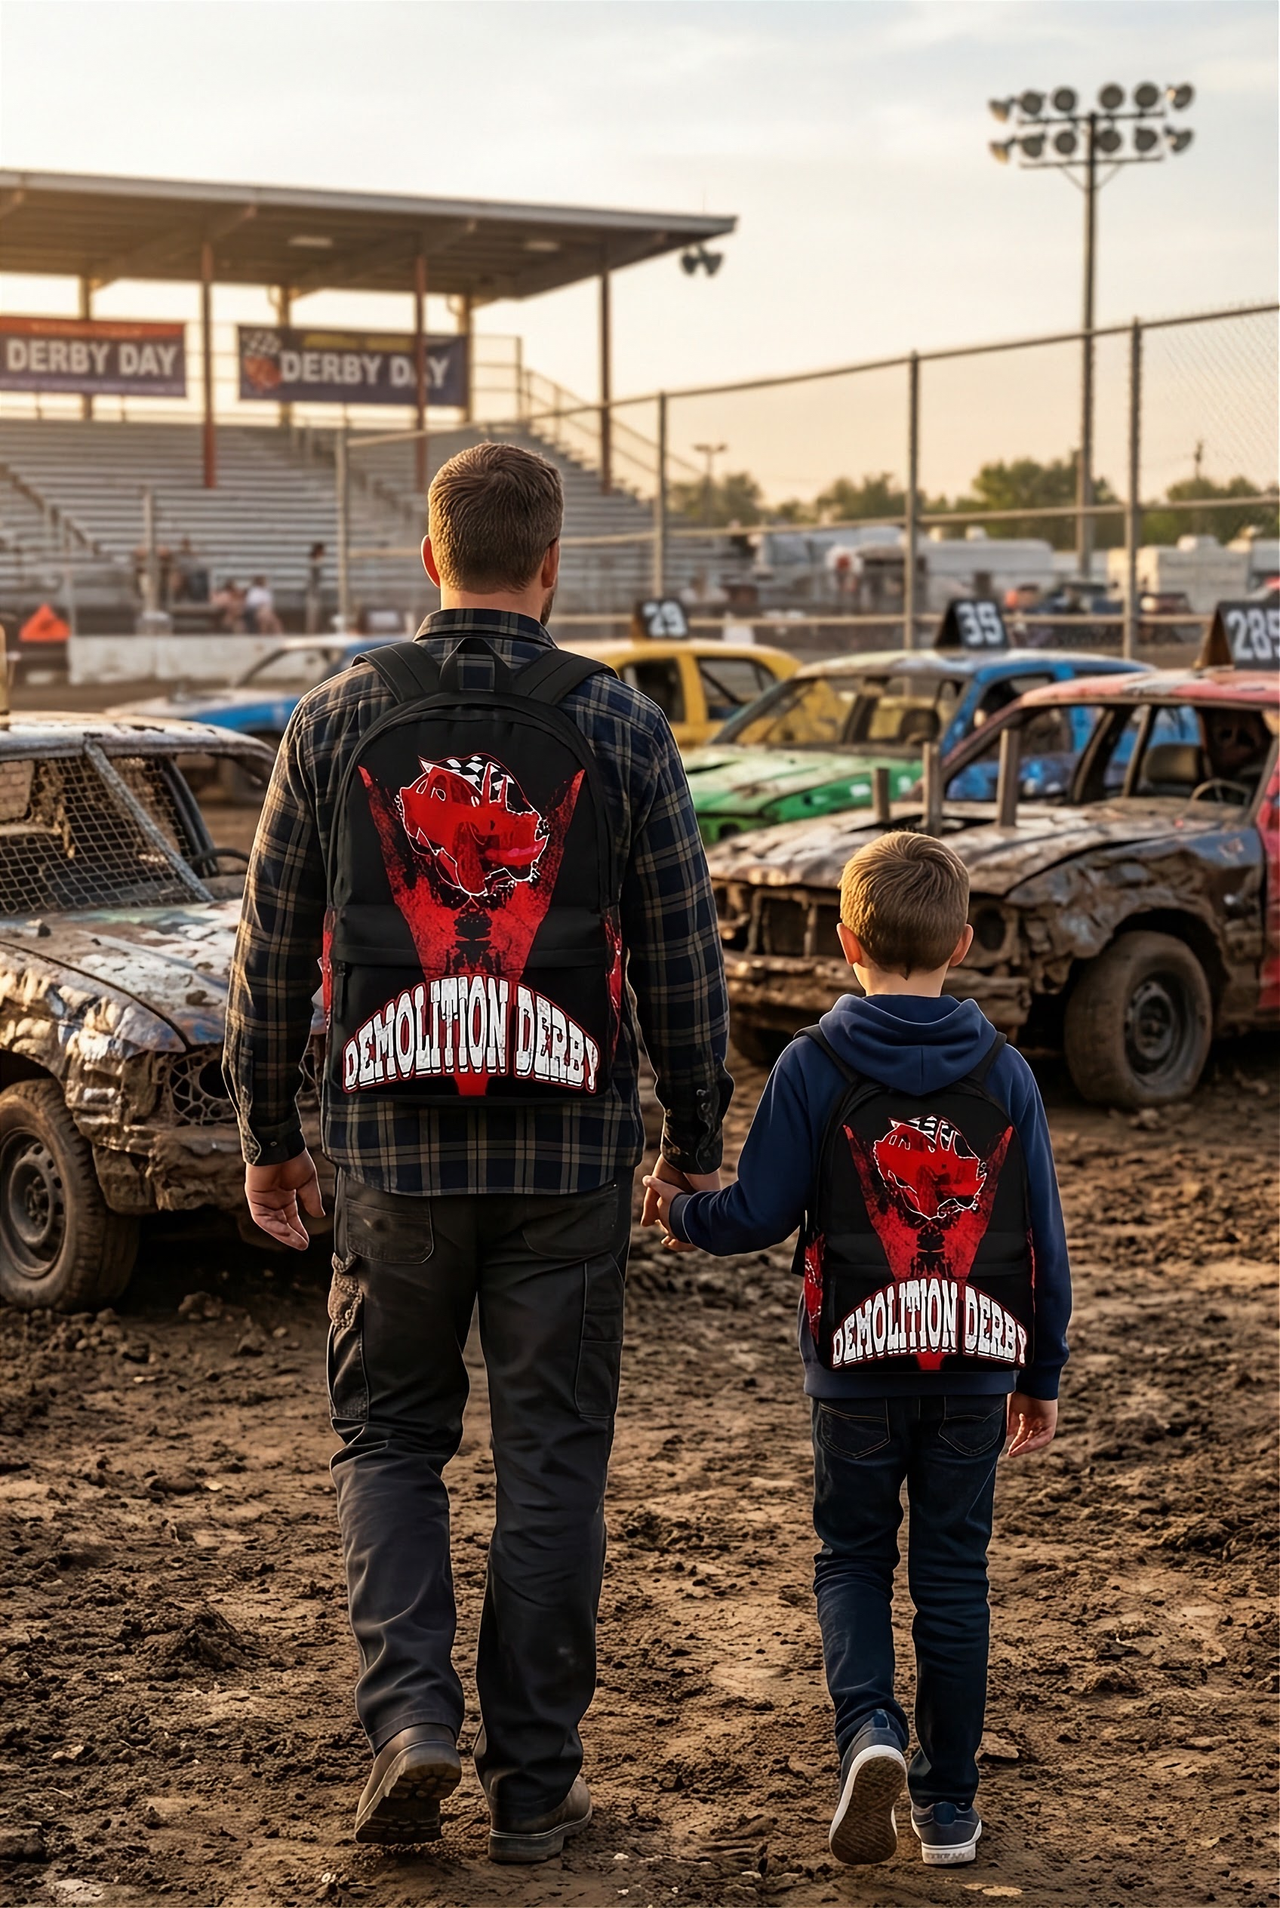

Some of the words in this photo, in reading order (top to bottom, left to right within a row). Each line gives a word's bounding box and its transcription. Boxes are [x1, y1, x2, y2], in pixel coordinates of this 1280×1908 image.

[6, 338, 110, 375] DERBY
[118, 343, 178, 376] DAY
[281, 351, 382, 385] DERBY
[344, 975, 508, 1092] DEMOLITION
[515, 983, 599, 1093] DERBY
[832, 1278, 958, 1368] DEMOLITION
[963, 1285, 1027, 1367] DERBY
